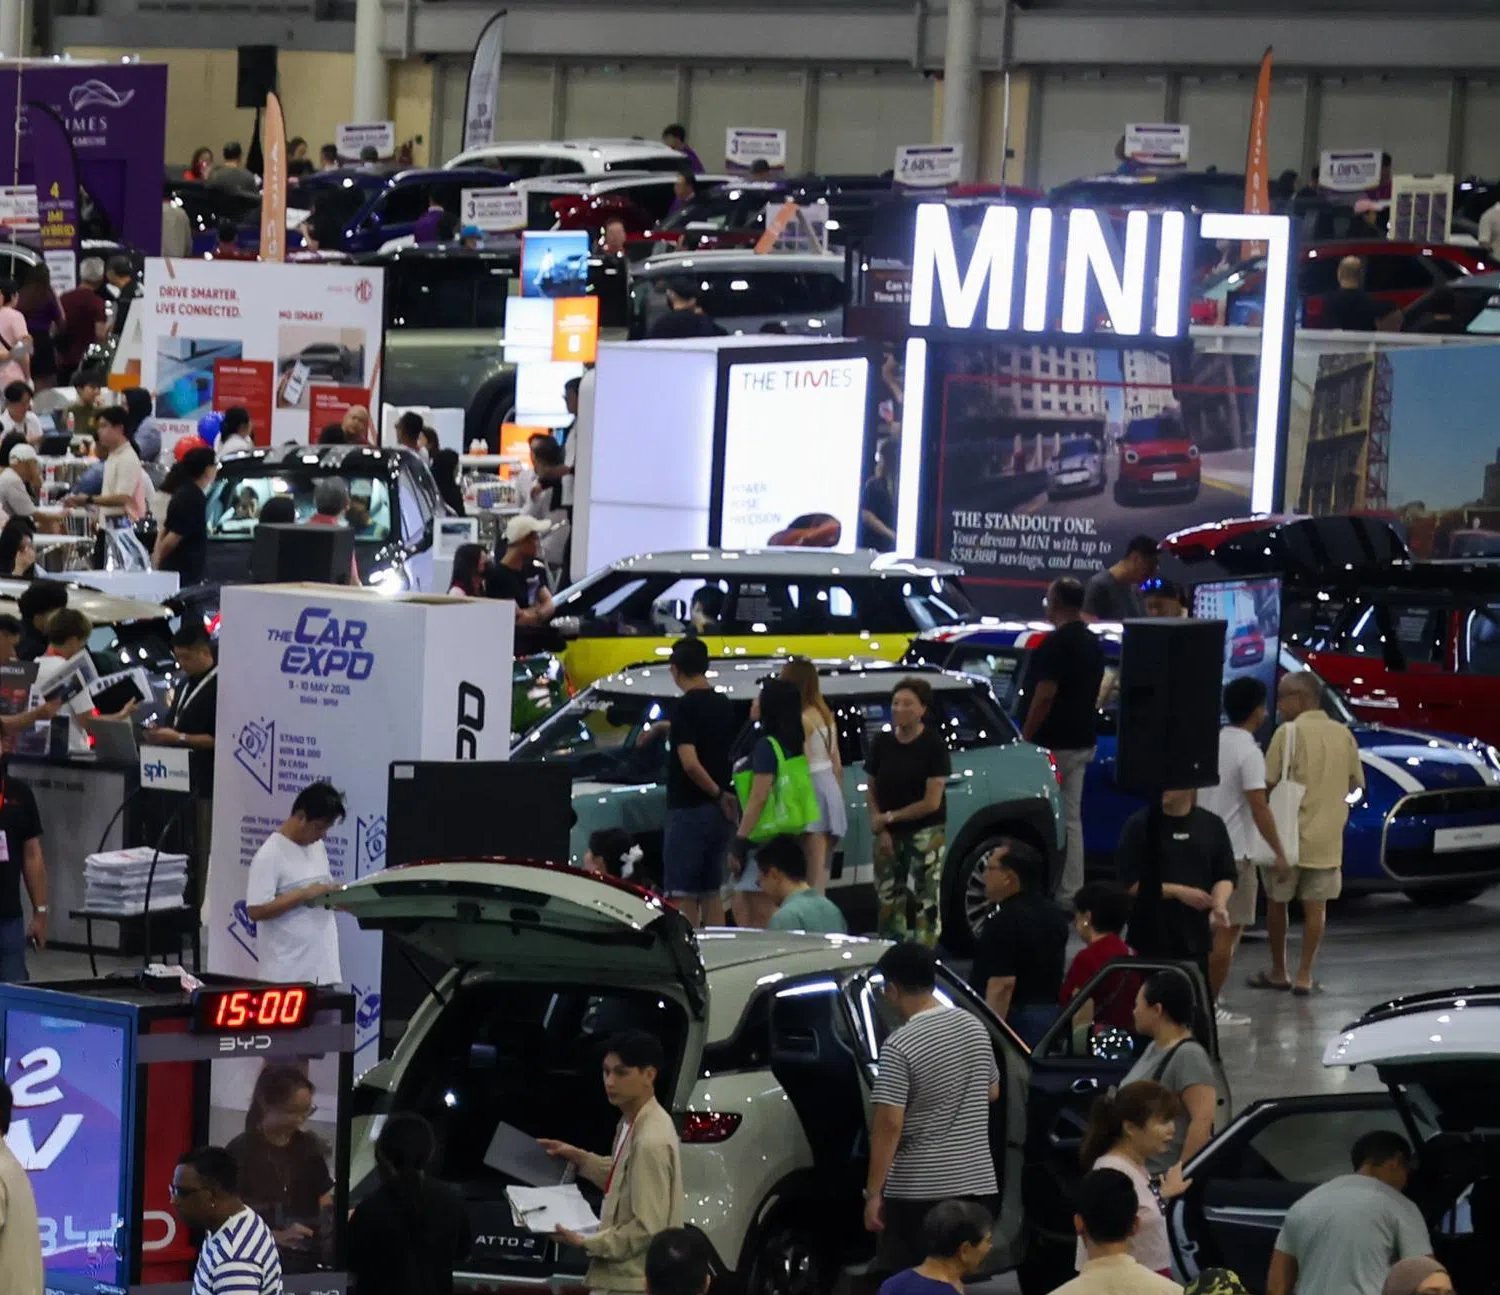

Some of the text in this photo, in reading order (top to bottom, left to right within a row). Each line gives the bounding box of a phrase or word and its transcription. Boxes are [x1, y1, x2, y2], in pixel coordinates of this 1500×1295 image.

[909, 202, 1186, 337] MINI
[159, 285, 240, 301] DRIVE SMARTER.
[155, 302, 242, 318] LIVE CONNECTED.
[743, 369, 852, 391] THE TIMES
[952, 510, 1097, 535] THE STANDOUT ONE.
[951, 530, 1112, 555] Your dream MINI with up to
[1047, 552, 1072, 568] and
[267, 607, 368, 649] THE CAR
[280, 645, 375, 680] EXPO
[310, 683, 328, 693] MAY
[306, 736, 317, 746] TO
[143, 760, 167, 782] sph
[288, 760, 308, 770] CASH
[215, 990, 305, 1026] 15:00
[219, 1035, 272, 1052] BYD
[475, 1234, 535, 1249] ATTO 2
